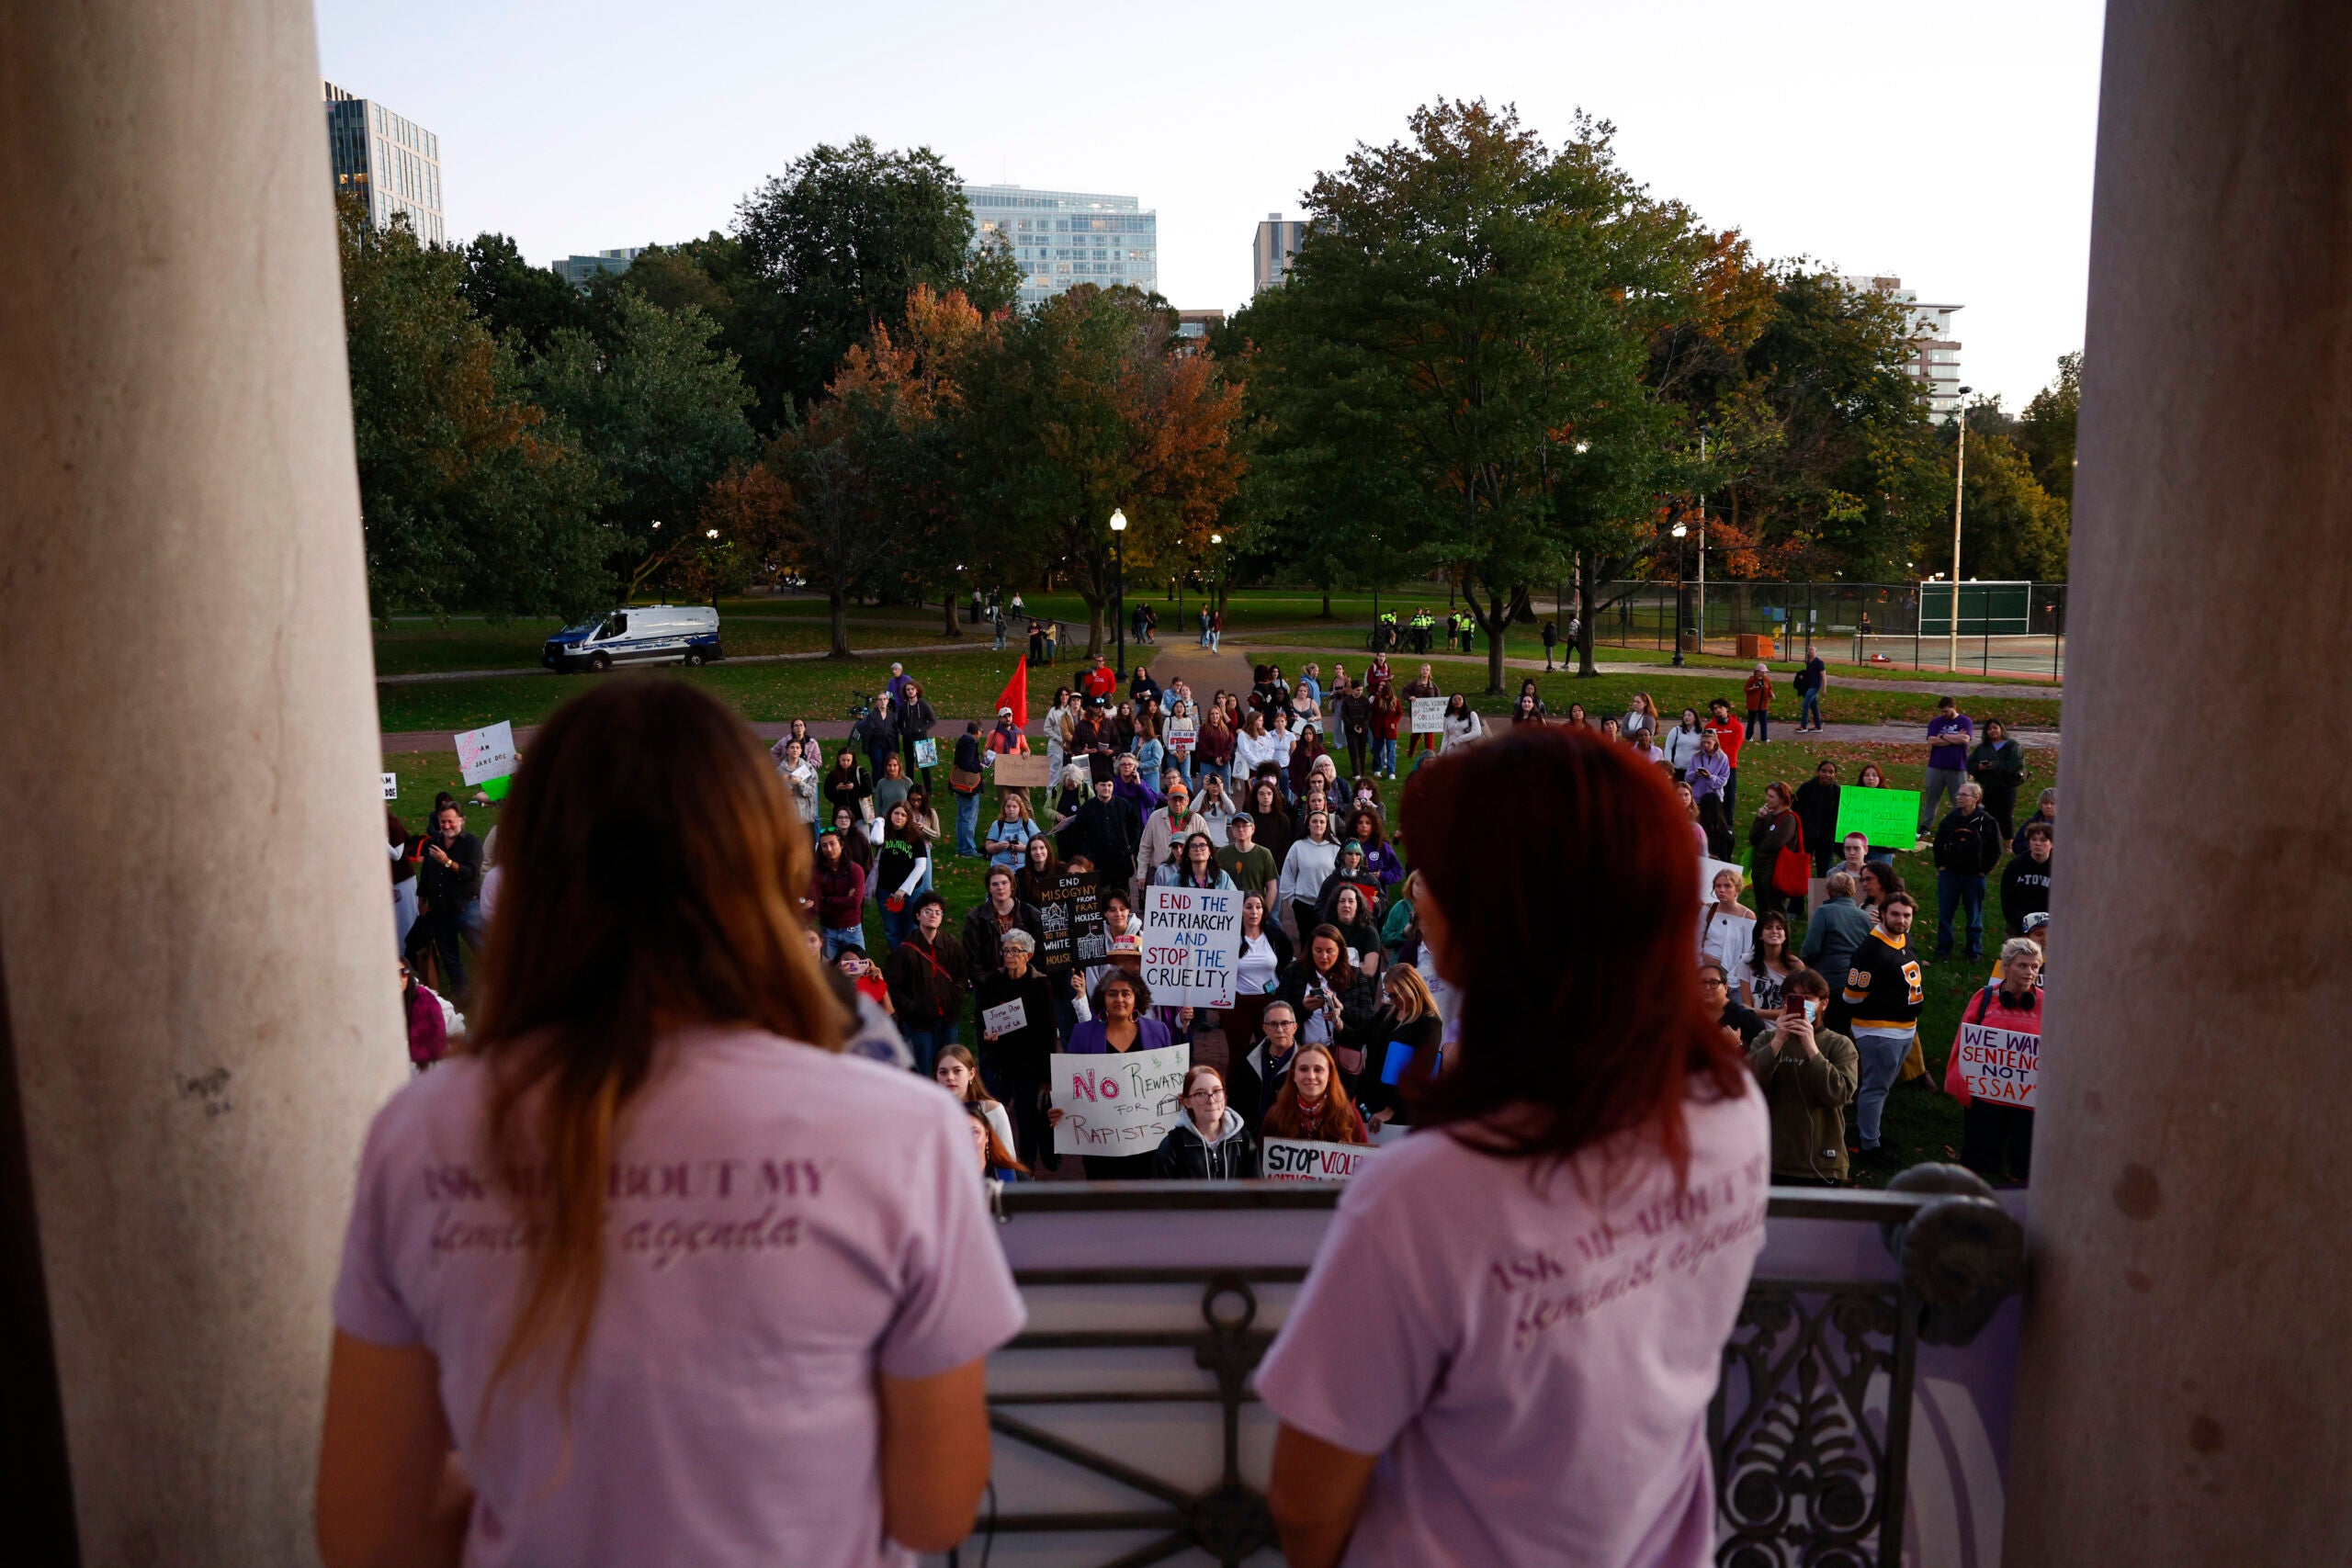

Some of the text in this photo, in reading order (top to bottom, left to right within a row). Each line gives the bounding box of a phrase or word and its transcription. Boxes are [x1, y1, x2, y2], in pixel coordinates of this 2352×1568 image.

[475, 753, 506, 768] JANE DOE
[1059, 878, 1080, 887] END
[1041, 885, 1098, 900] MISOGYNY
[1075, 902, 1098, 912] FRAT
[1159, 893, 1228, 912] END THE
[1075, 912, 1102, 922] HOUSE
[1150, 911, 1234, 931] PATRIARCHY
[1044, 939, 1070, 951] WHITE
[1174, 931, 1207, 946] AND
[1046, 953, 1072, 964] HOUSE
[1146, 947, 1226, 967] STOP THE
[1147, 968, 1229, 988] CRUELTY
[1847, 968, 1871, 987] 88
[989, 1010, 1006, 1020] Jane
[991, 1025, 1002, 1033] All
[1965, 1027, 1998, 1048] WE
[1983, 1064, 2029, 1082] NOT
[1966, 1076, 2036, 1101] ESSAY
[1114, 1103, 1149, 1115] FOR
[1066, 1115, 1166, 1145] RAPISTS
[1268, 1145, 1319, 1174] STOP
[605, 1160, 743, 1199] BOUT
[758, 1160, 834, 1198] MY
[623, 1203, 800, 1271] agenda
